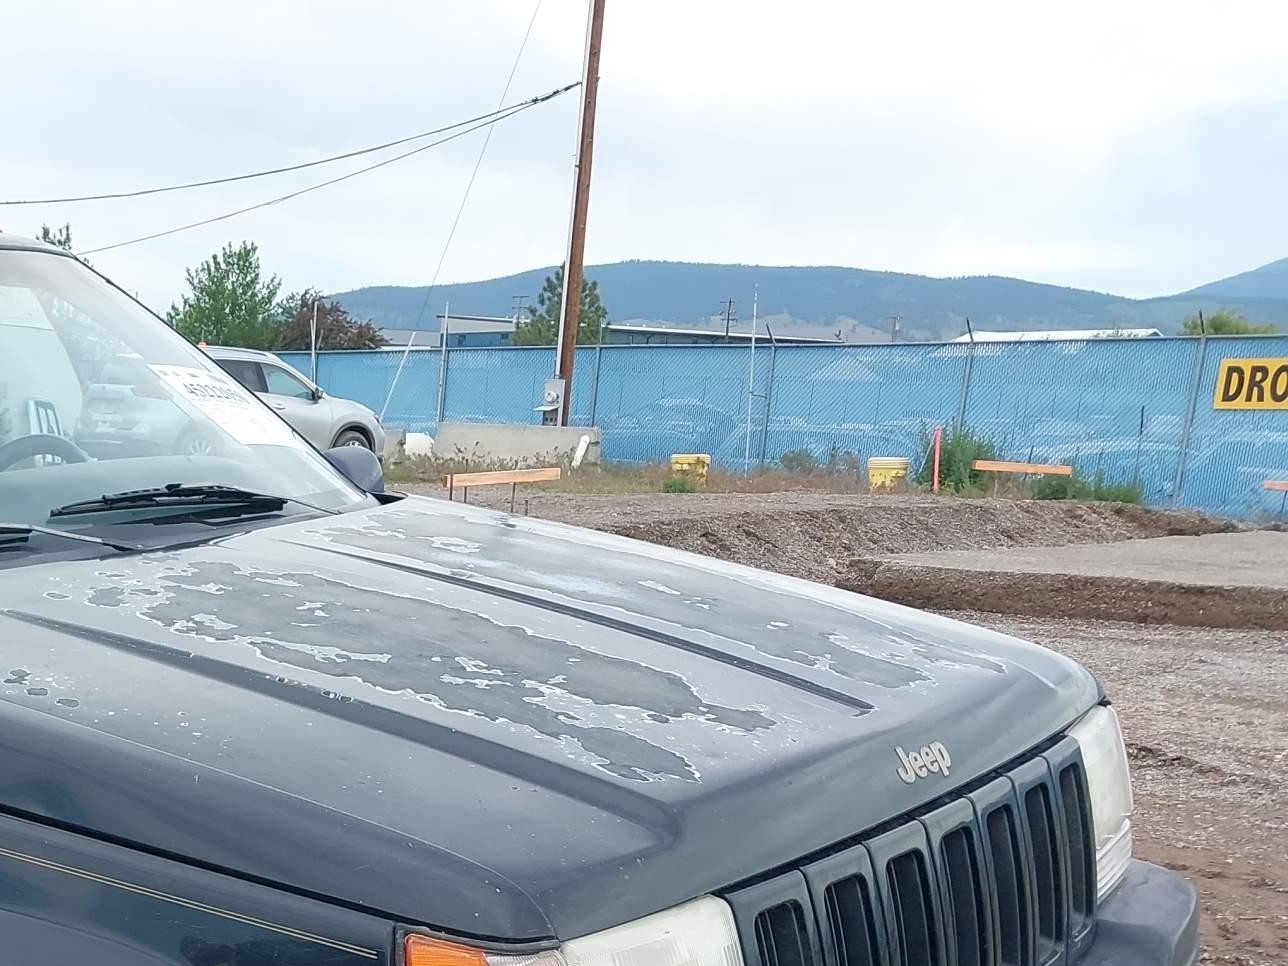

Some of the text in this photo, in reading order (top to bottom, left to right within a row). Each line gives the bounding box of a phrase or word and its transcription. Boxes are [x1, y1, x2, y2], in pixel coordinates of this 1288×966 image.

[183, 383, 250, 405] 45222
[1220, 364, 1288, 403] DRO
[894, 741, 951, 784] Jeep
